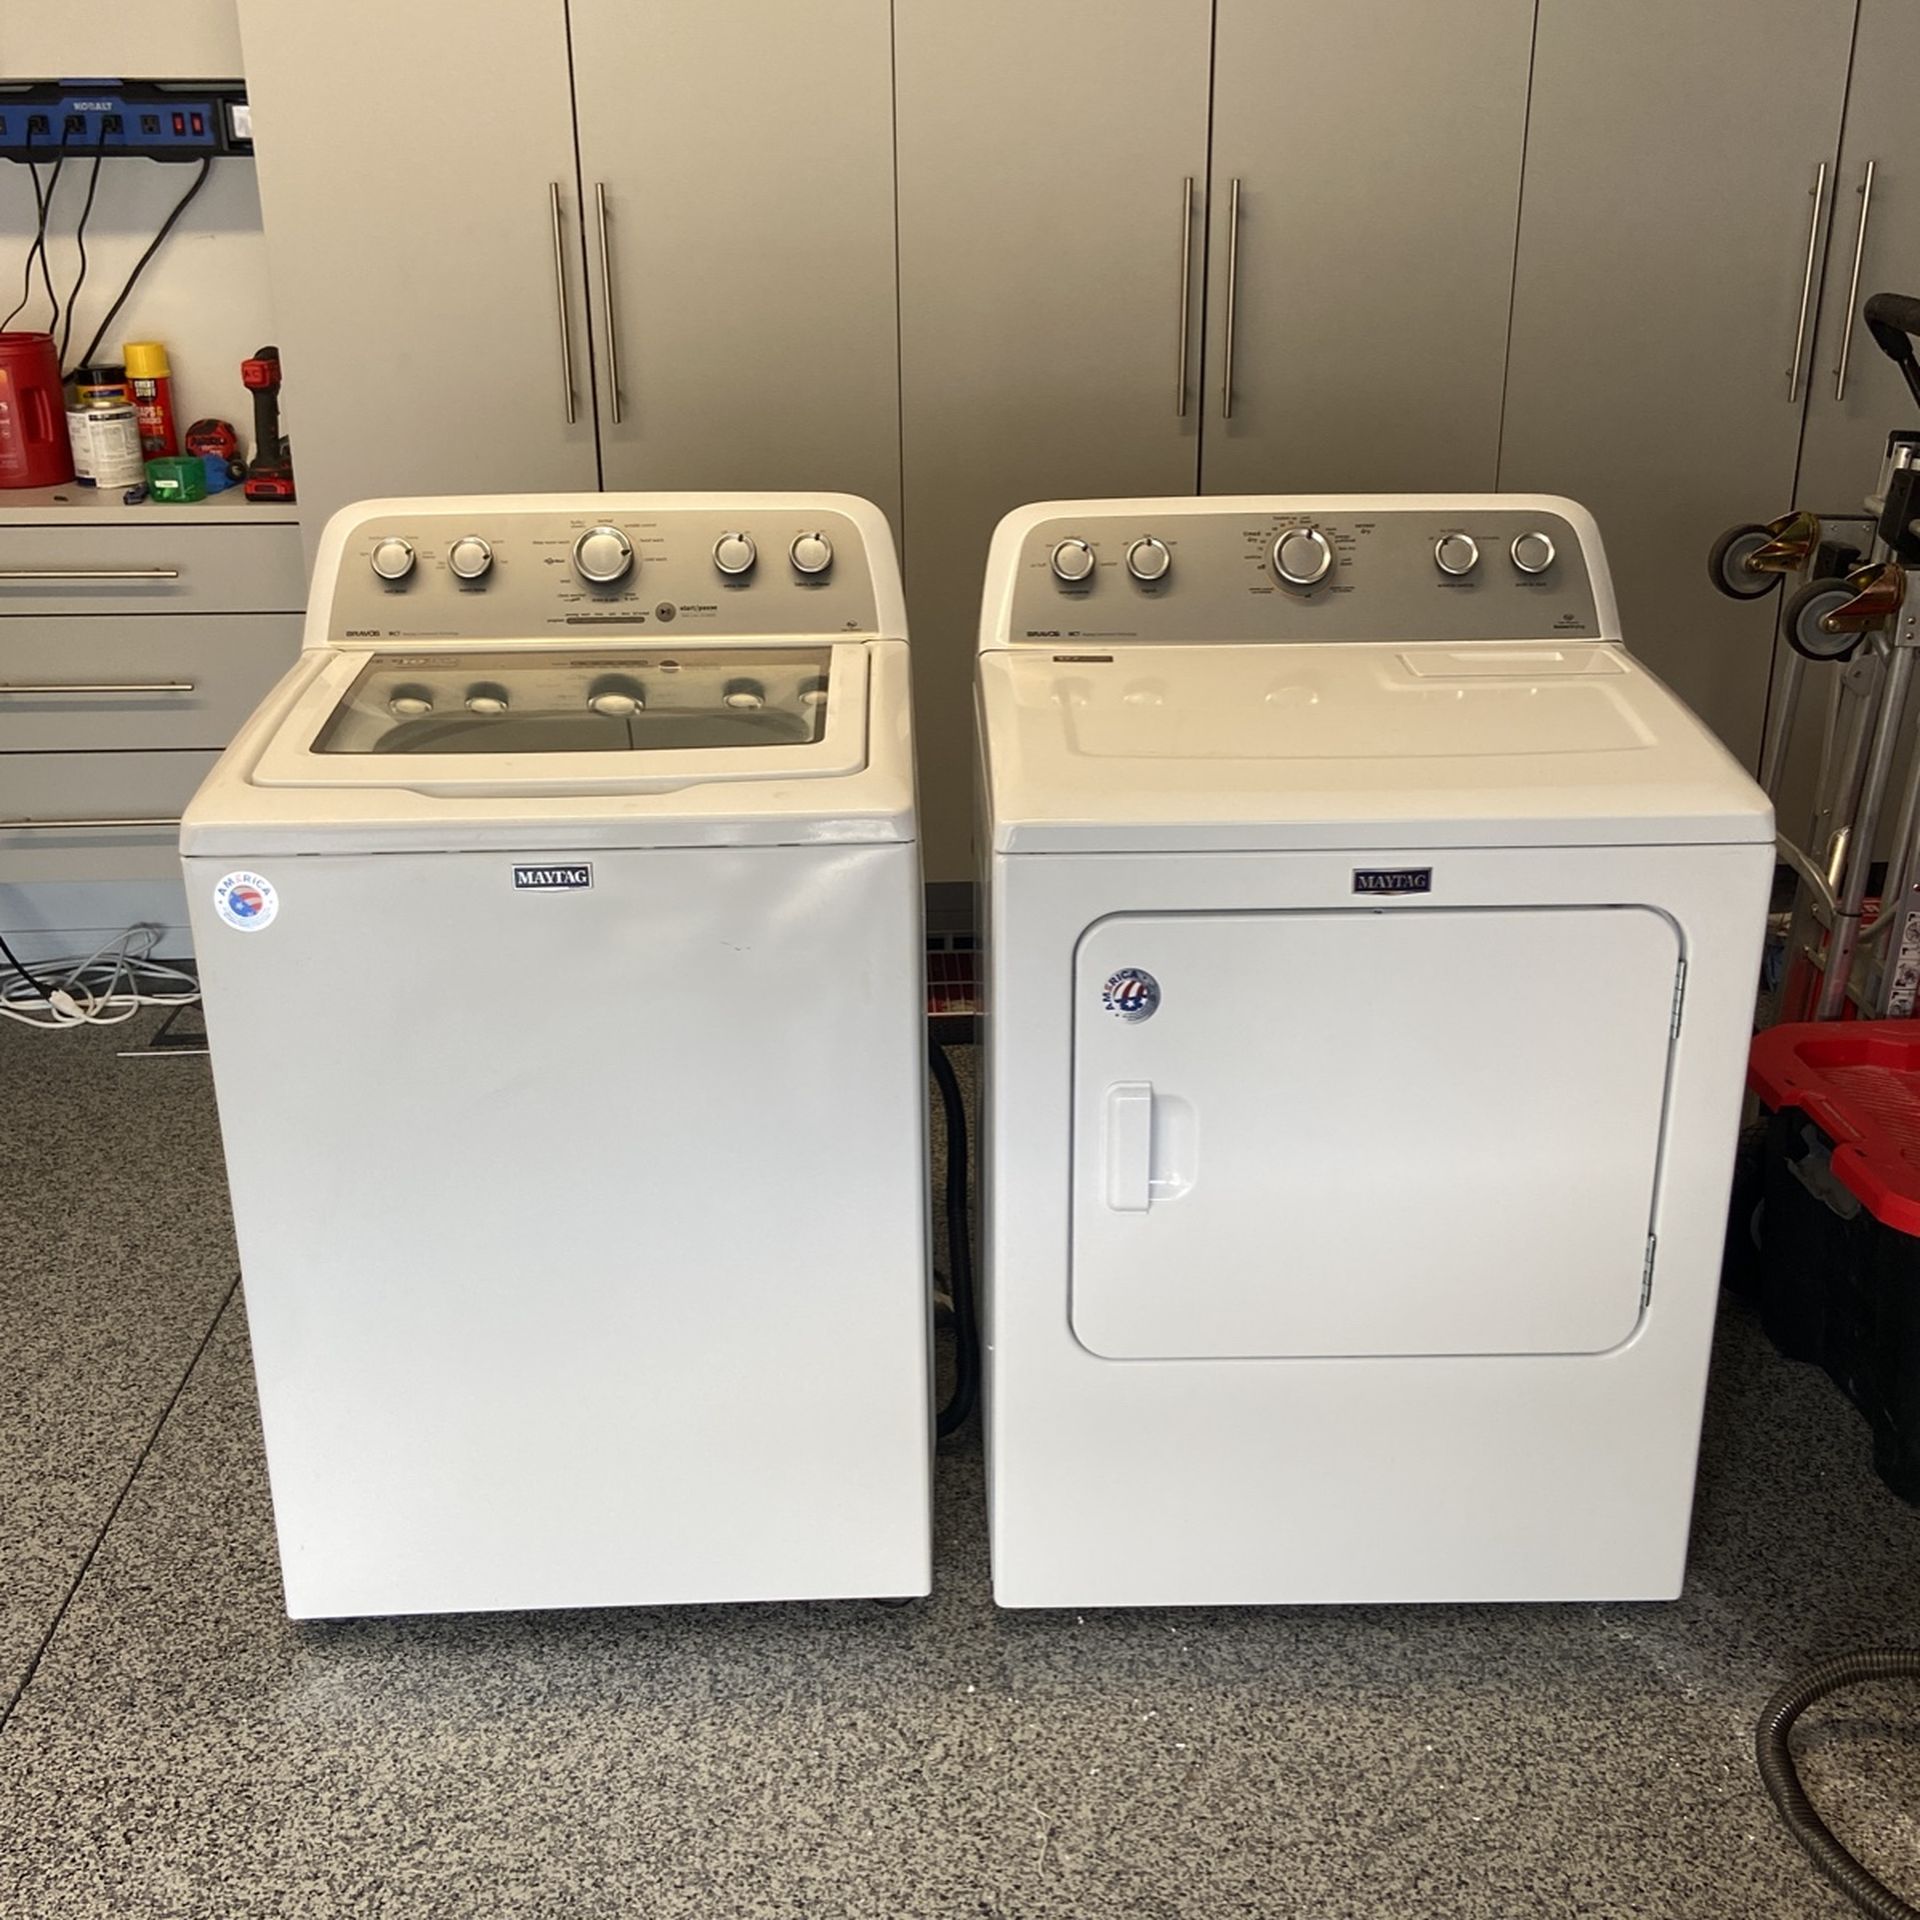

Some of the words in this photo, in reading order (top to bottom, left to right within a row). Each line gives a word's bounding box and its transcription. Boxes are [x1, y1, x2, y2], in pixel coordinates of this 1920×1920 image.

[73, 102, 113, 111] KOBALT
[218, 874, 271, 896] AMERICA
[517, 870, 588, 885] MAYTAG
[1358, 874, 1426, 889] MAYTAG
[1102, 970, 1138, 1010] AMERICA
